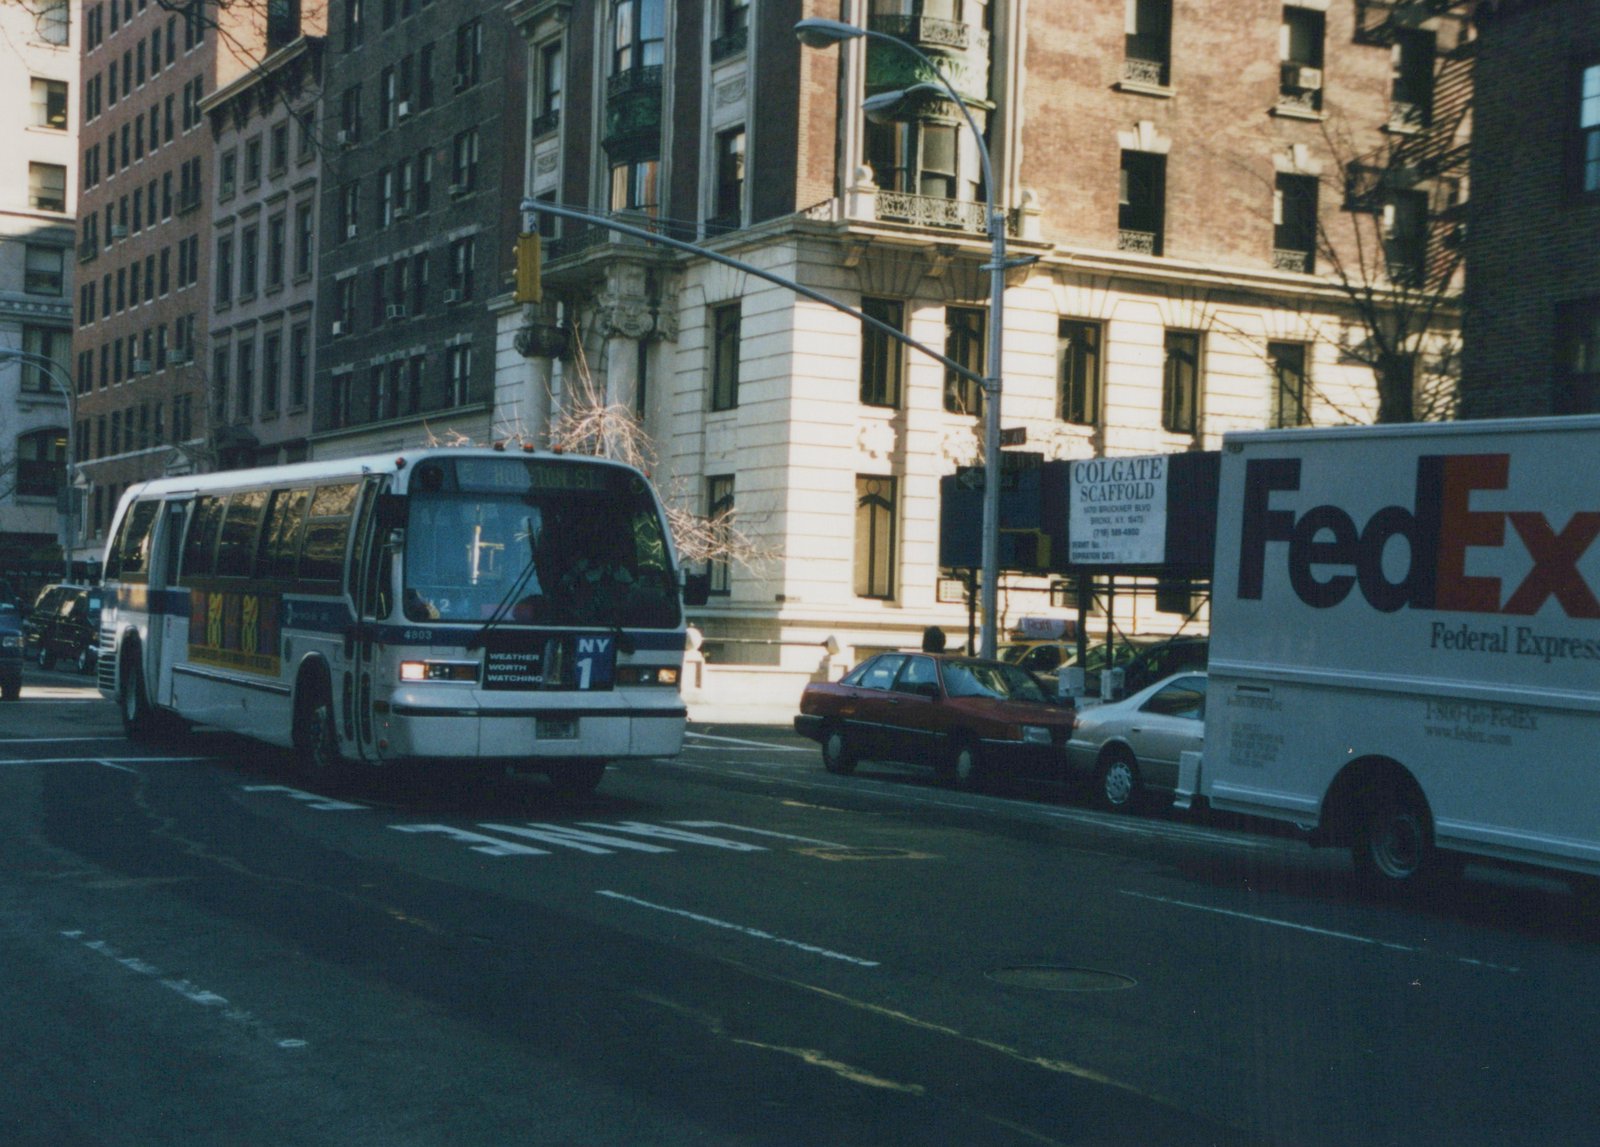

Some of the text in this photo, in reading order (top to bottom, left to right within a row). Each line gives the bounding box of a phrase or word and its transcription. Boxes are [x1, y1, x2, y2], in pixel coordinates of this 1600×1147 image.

[1075, 457, 1162, 484] COLGATE
[1080, 482, 1154, 502] SCAFFOLD
[1135, 503, 1151, 512] BLVD
[1237, 453, 1600, 618] FedEx
[578, 638, 610, 653] NY
[1430, 621, 1600, 664] Federal Express
[490, 653, 540, 661] WEATHER
[488, 663, 527, 671] WORTH
[576, 657, 593, 690] 1
[487, 674, 543, 683] WATCHING
